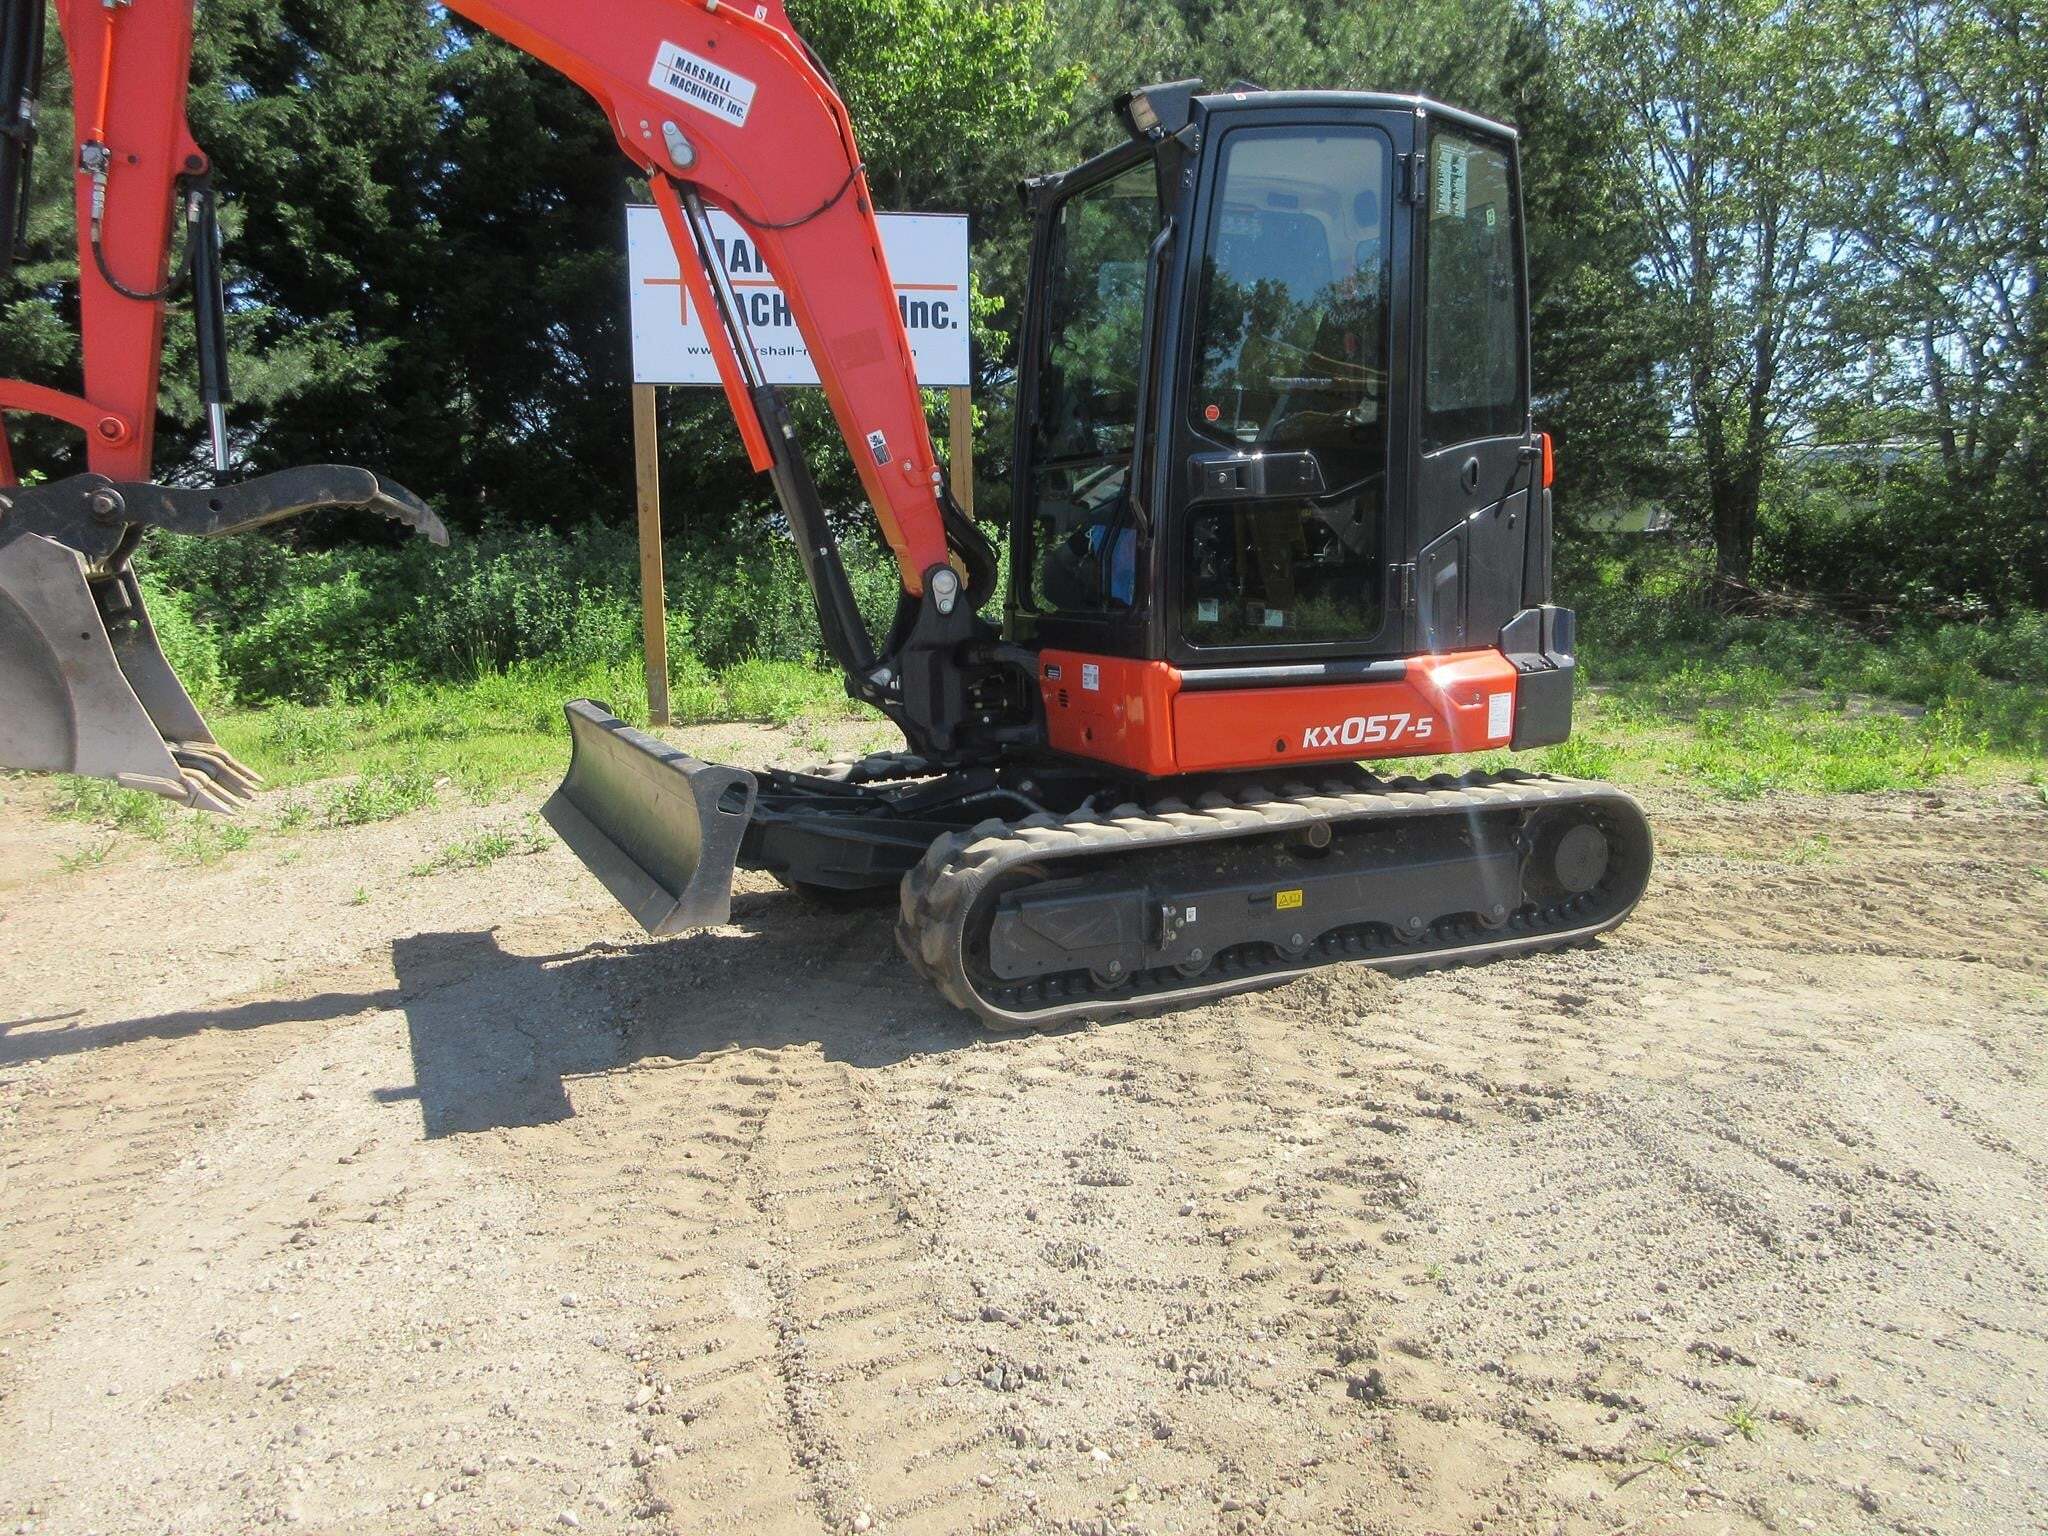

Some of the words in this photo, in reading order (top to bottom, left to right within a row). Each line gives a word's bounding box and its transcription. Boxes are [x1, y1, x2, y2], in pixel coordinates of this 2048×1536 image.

[675, 57, 731, 92] MARSHALL
[669, 74, 725, 110] MACHINERY,
[726, 101, 744, 118] Inc.
[899, 296, 957, 329] Inc.
[1303, 713, 1432, 748] KX057-5
